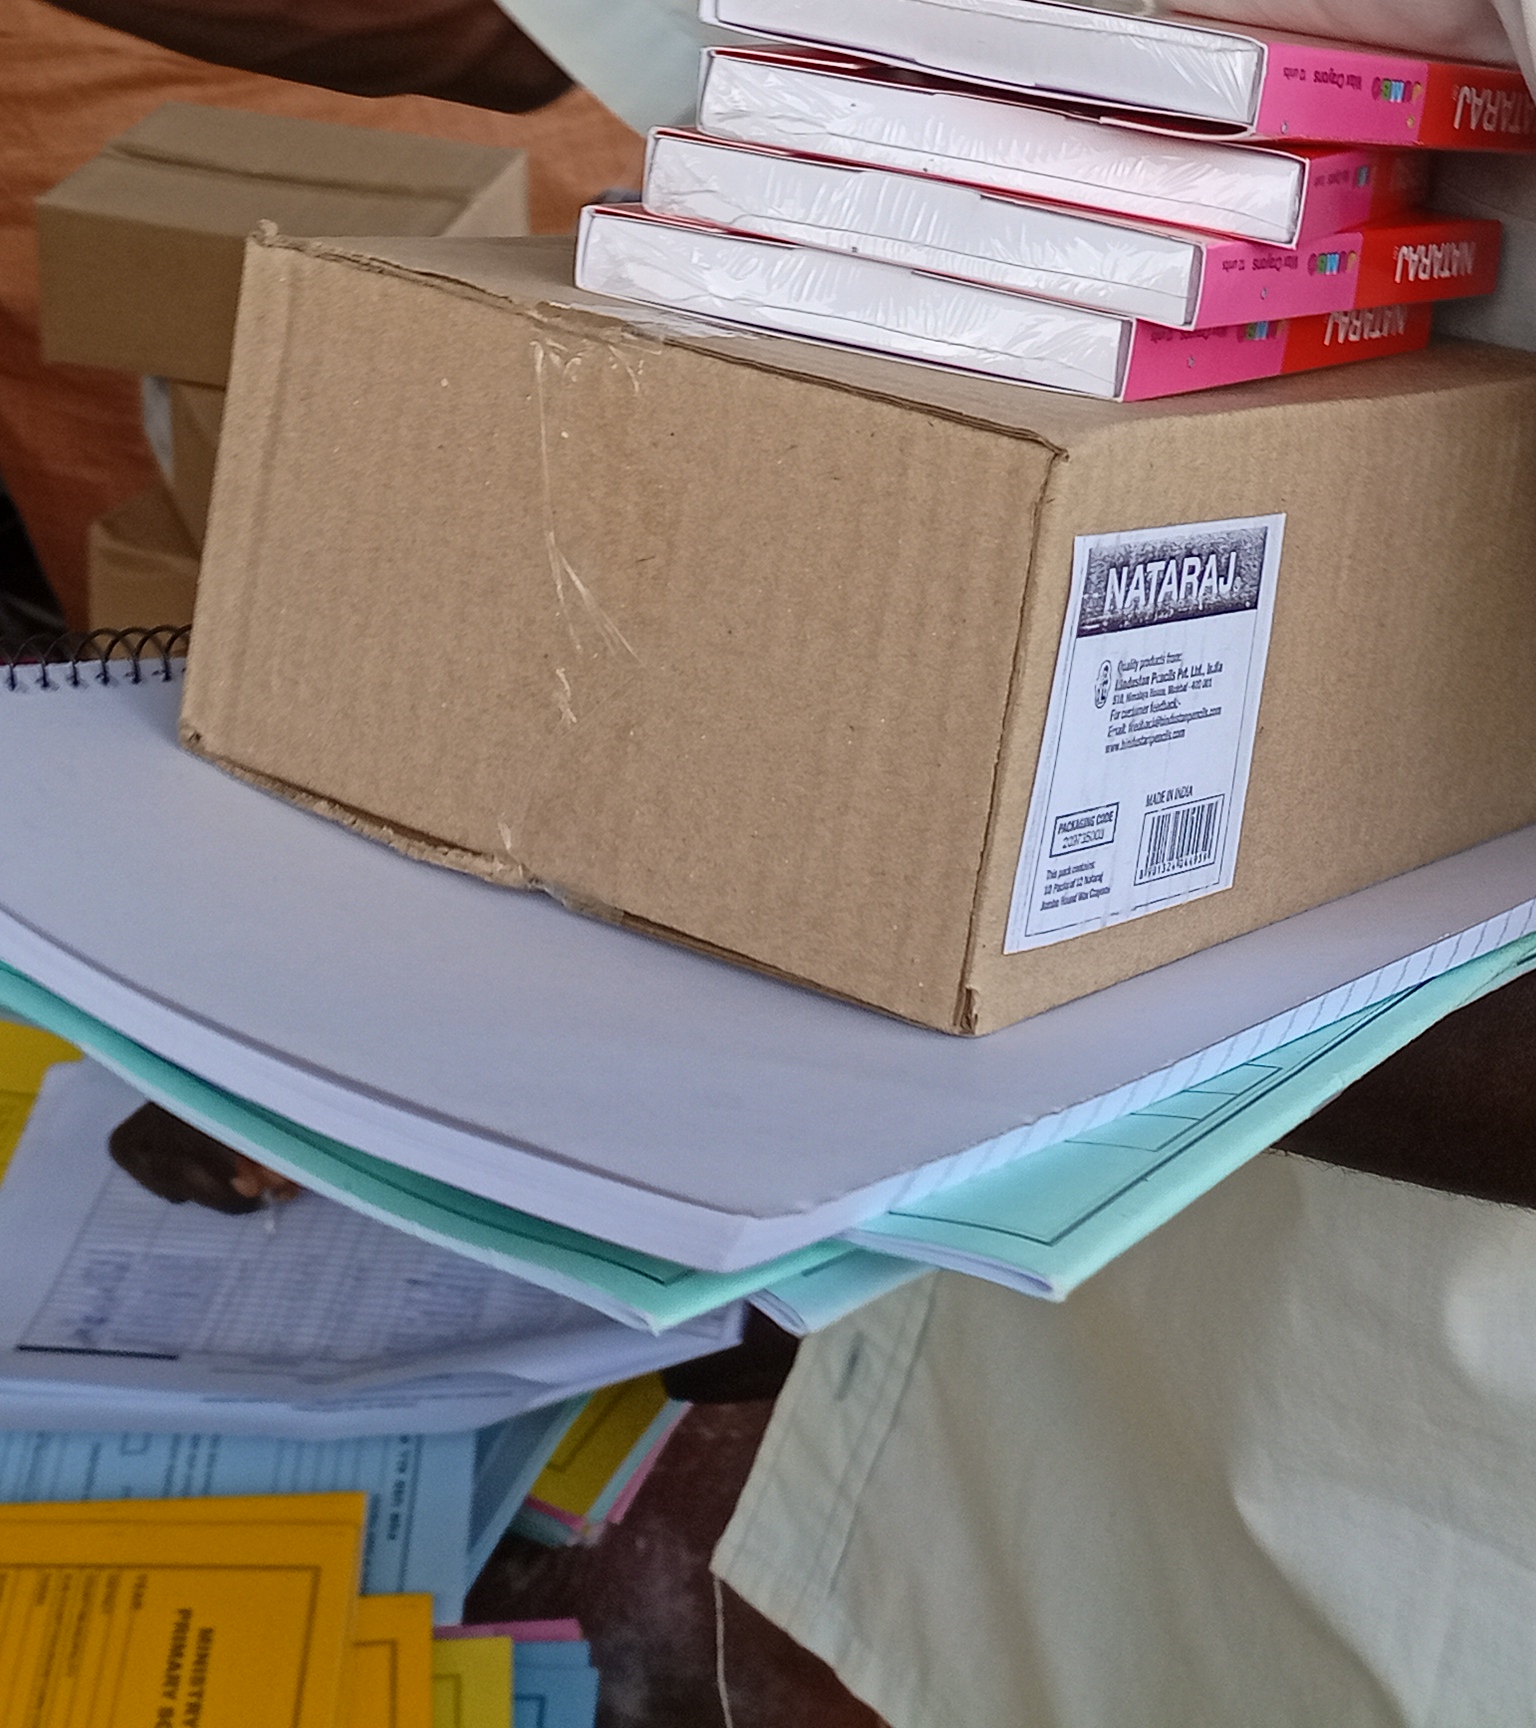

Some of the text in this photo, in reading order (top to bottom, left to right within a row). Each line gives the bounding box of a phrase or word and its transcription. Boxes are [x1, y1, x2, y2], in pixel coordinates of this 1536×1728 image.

[1313, 68, 1345, 89] Crayons
[1372, 76, 1422, 103] JUMBO
[1307, 250, 1358, 277] JUMBO
[1394, 242, 1476, 284] NATARAJ
[1324, 306, 1408, 346] NATARAJ
[1103, 551, 1237, 614] NATARAJ
[1145, 785, 1193, 807] MADE IN INDIA
[1058, 810, 1114, 834] PACKAGING CODE
